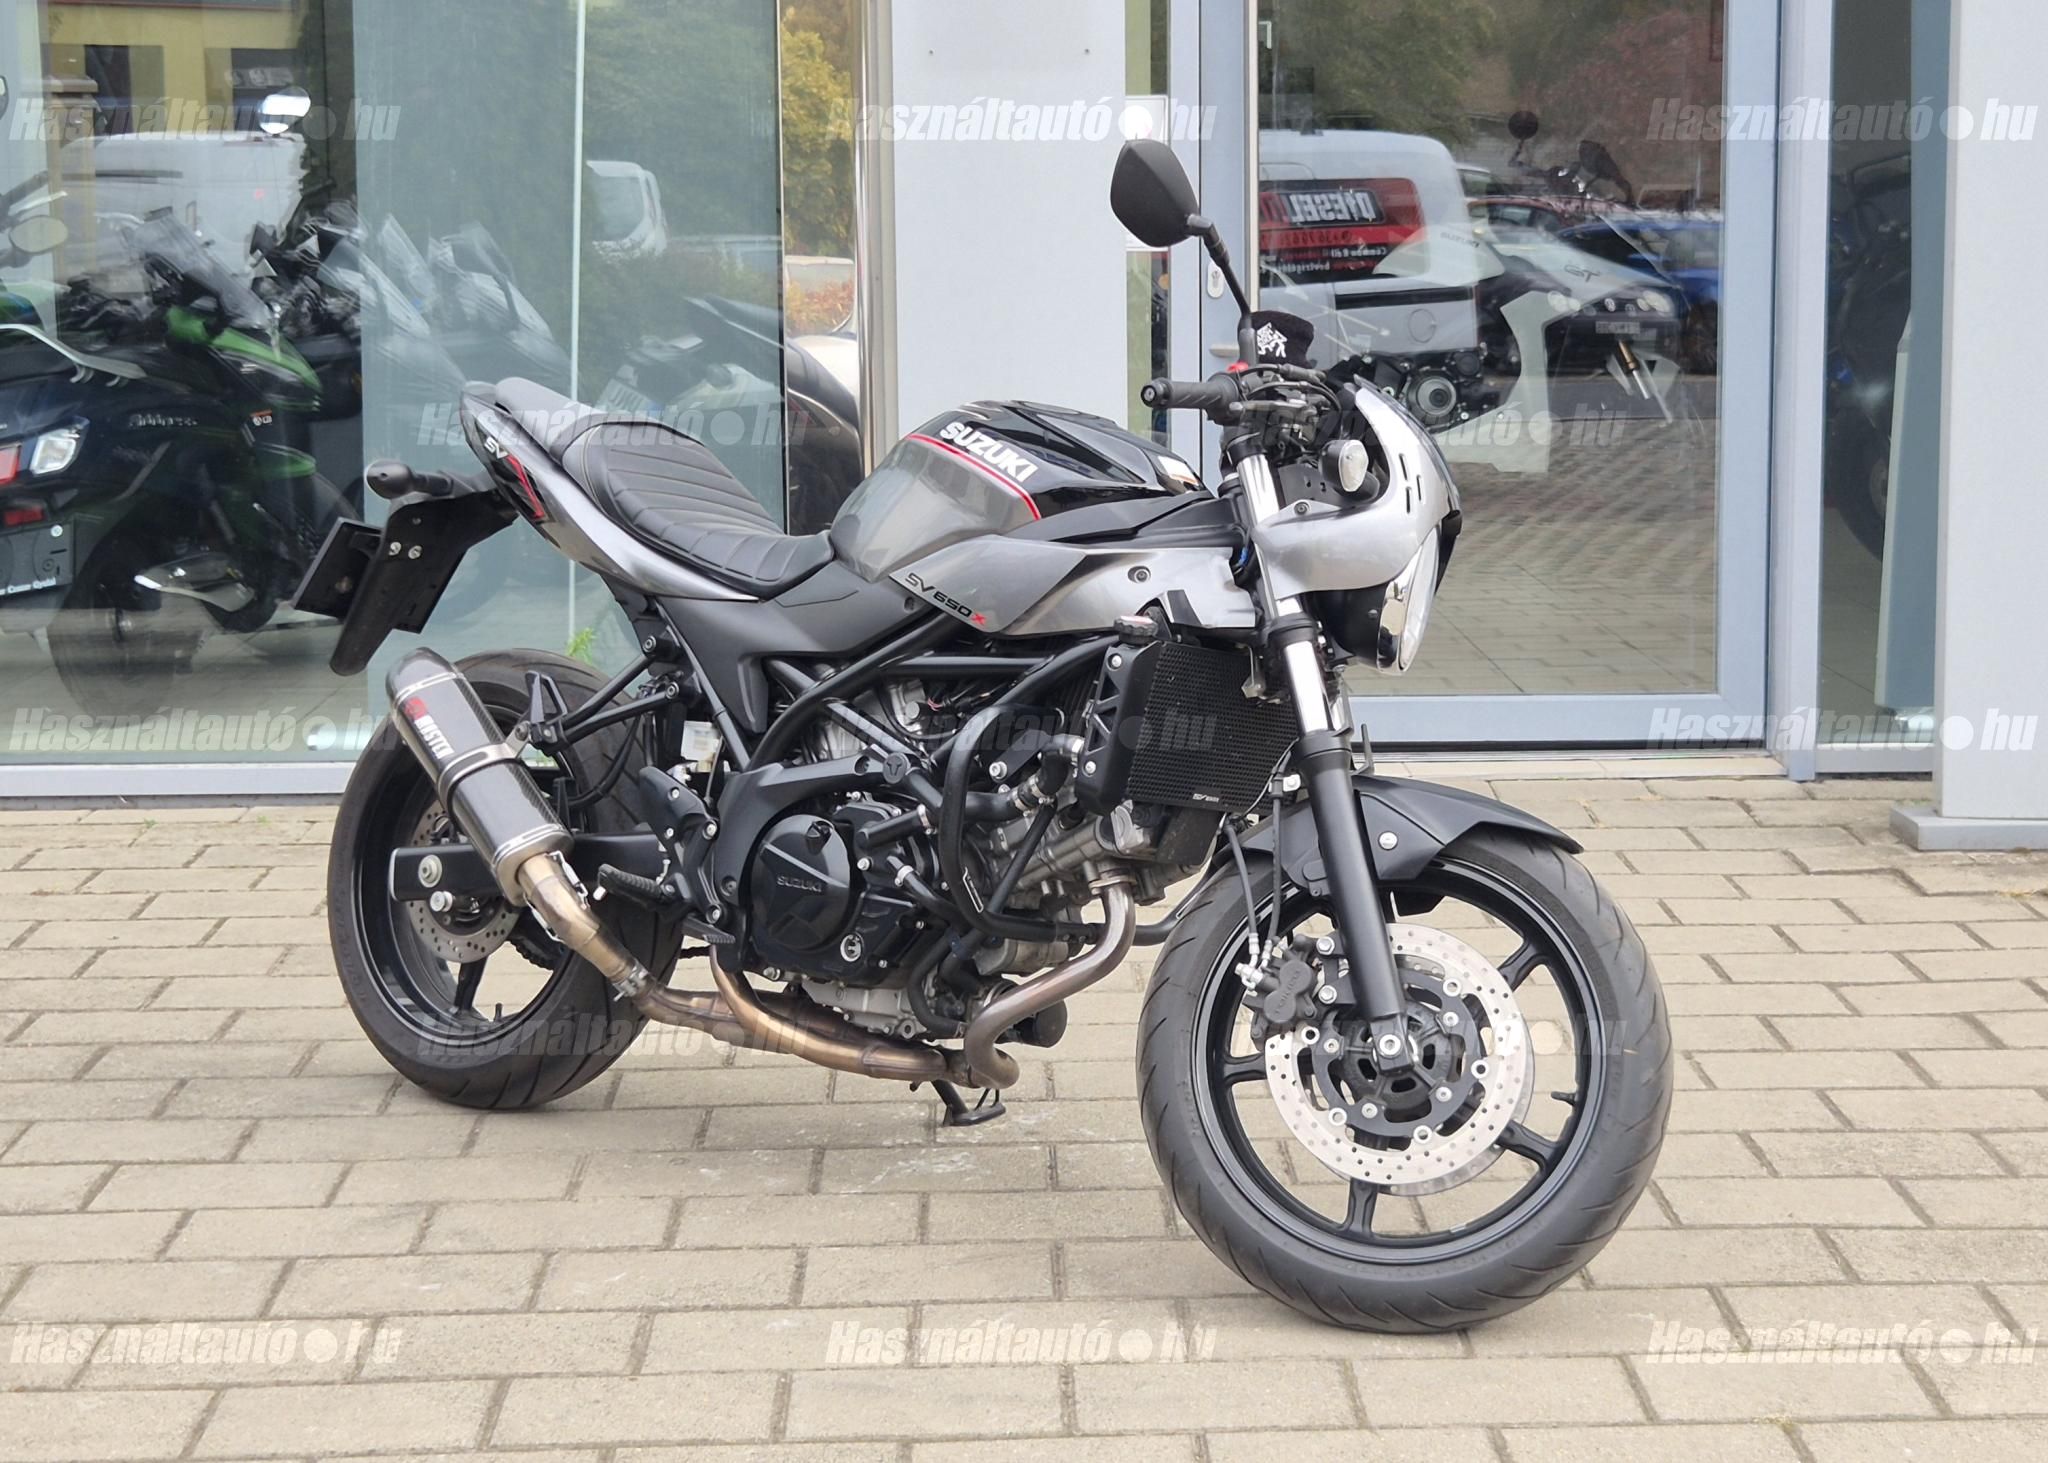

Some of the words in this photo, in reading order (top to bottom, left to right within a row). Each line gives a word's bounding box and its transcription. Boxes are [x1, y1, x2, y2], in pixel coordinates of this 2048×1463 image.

[1564, 264, 1599, 283] GT
[484, 436, 509, 459] SV
[940, 421, 1039, 483] SUZUKI
[777, 875, 822, 893] SUZUKI
